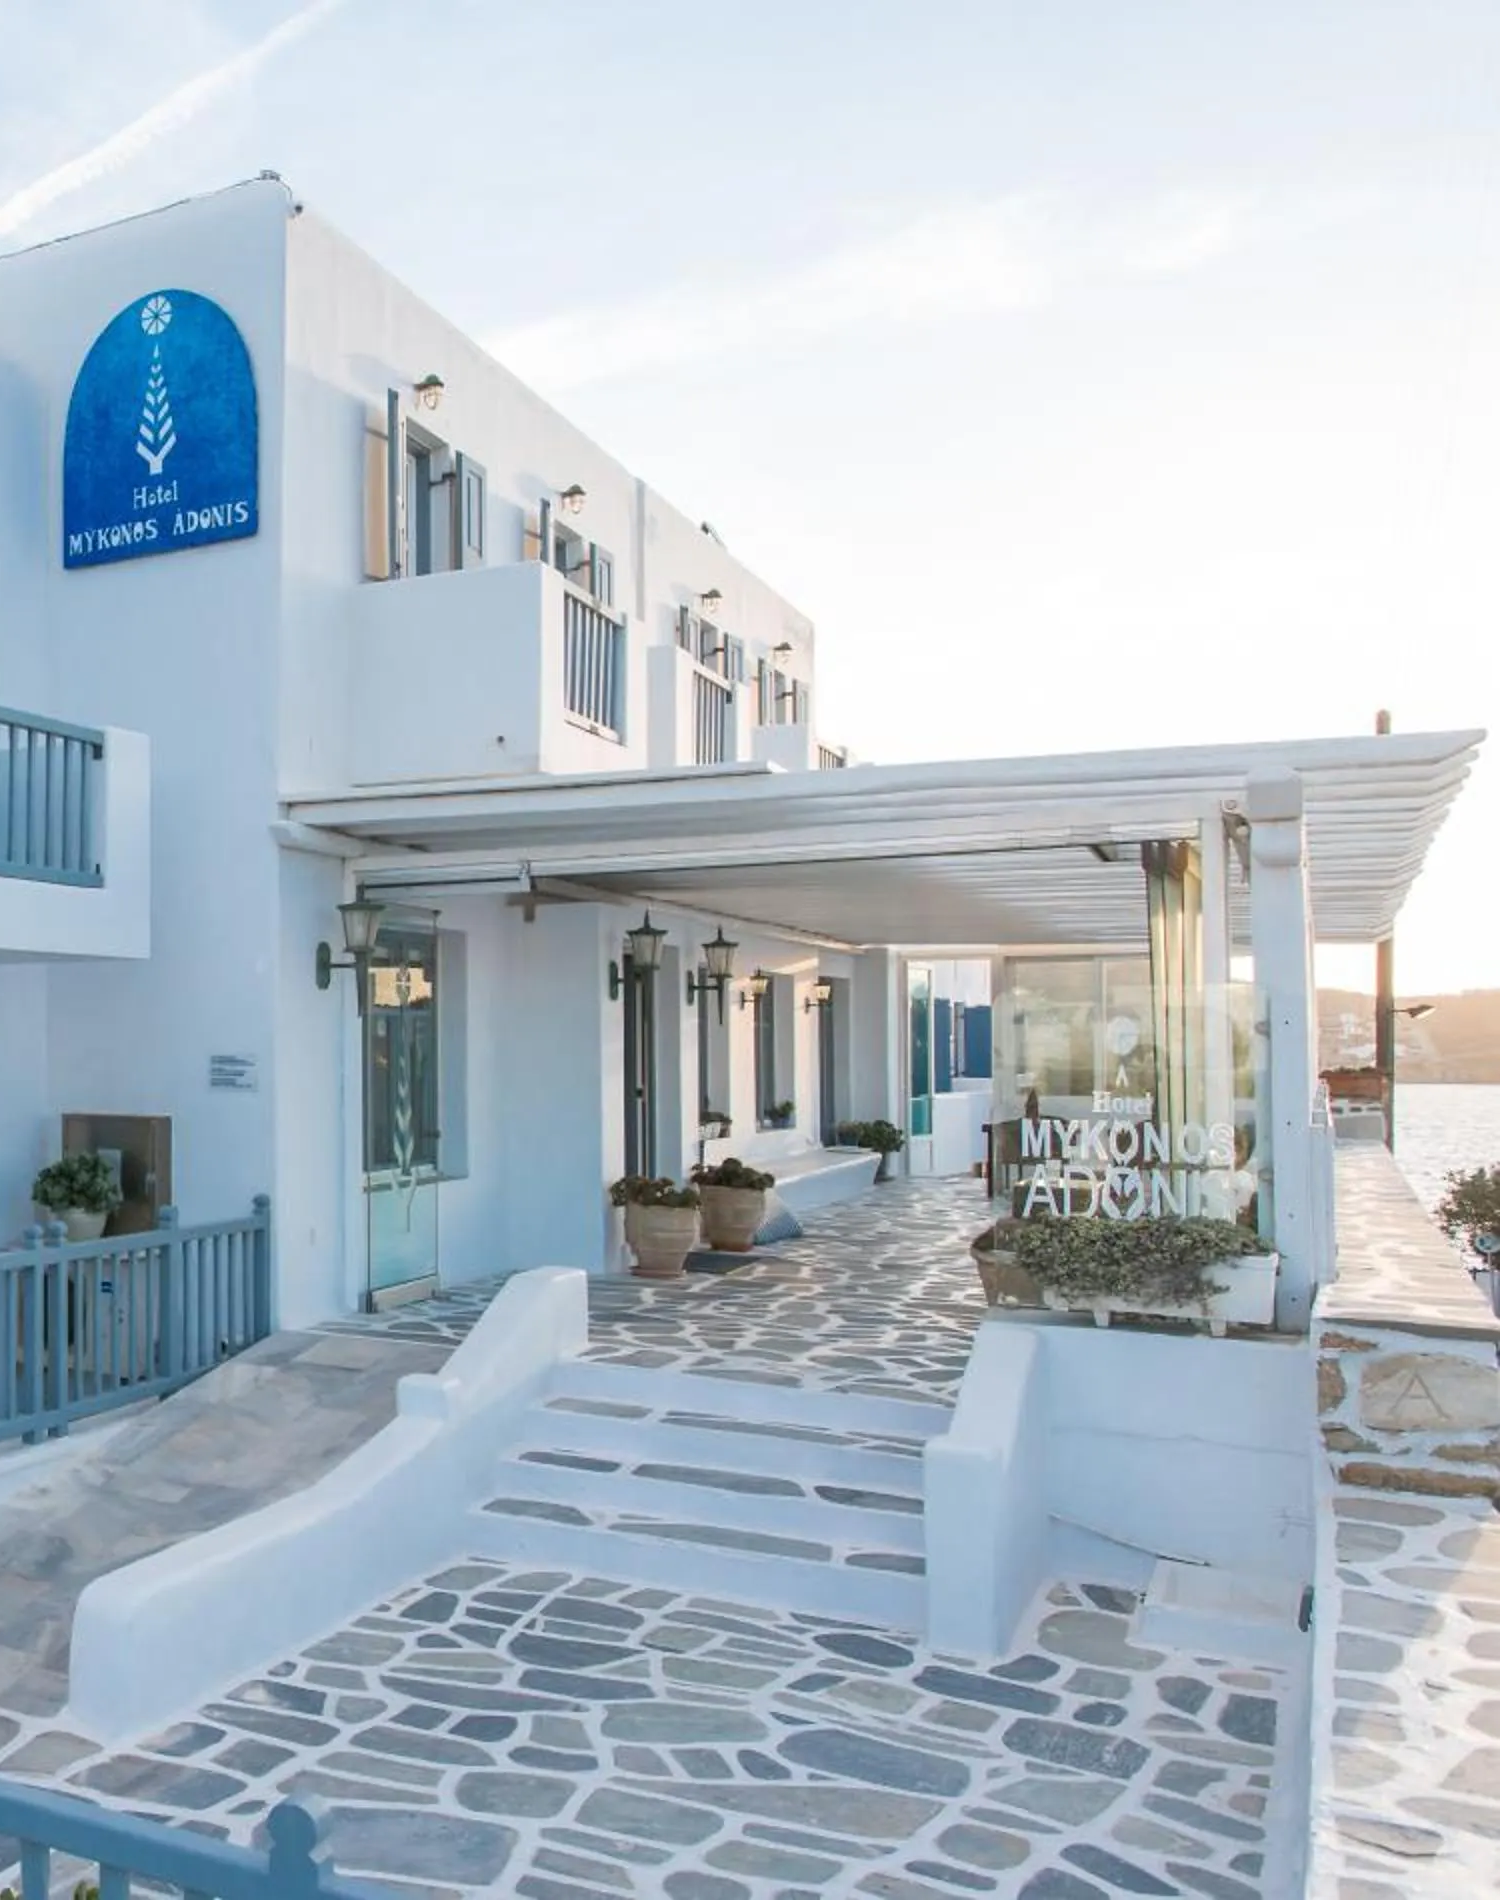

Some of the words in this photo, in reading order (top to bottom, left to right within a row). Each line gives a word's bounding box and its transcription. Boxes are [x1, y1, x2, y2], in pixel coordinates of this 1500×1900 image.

[133, 479, 178, 510] Hotel
[69, 519, 158, 556] MYKONOS
[173, 500, 249, 536] ADONIS
[1021, 1117, 1235, 1165] MYKONOS
